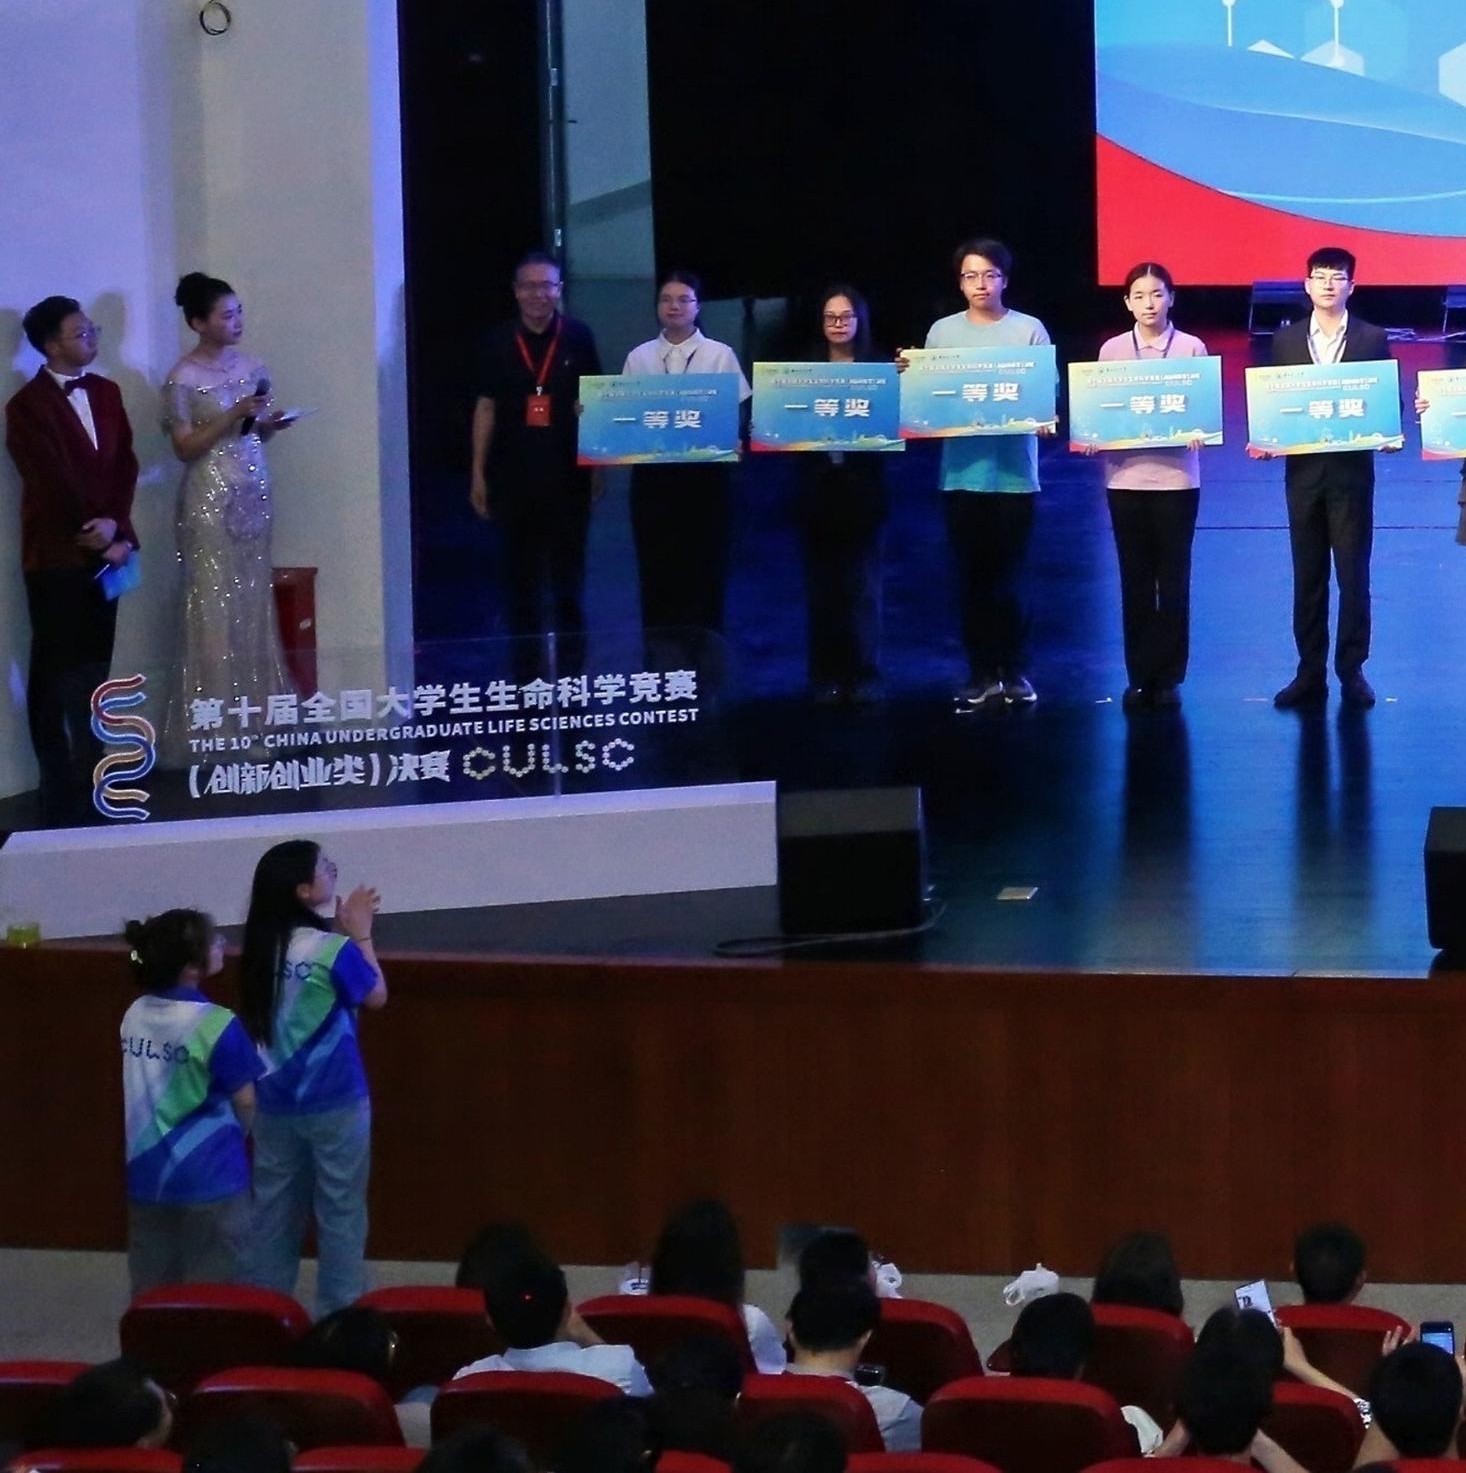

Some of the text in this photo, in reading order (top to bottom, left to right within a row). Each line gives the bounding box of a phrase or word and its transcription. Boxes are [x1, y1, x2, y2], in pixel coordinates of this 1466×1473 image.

[933, 383, 1019, 402] 一等奖
[784, 399, 870, 417] 一等奖
[1101, 395, 1186, 414] 一等奖
[1280, 399, 1365, 419] 一等奖
[614, 410, 702, 428] 一等奖
[189, 670, 698, 731] 第十届全国大学生生命科学竞赛
[189, 737, 226, 753] THE
[264, 732, 322, 748] CHINA
[326, 720, 484, 744] UNDERGRADUATE
[488, 718, 526, 734] LIFE
[529, 714, 615, 731] SCIENCES
[619, 708, 699, 725] CONTEST
[462, 737, 635, 780] CULSC
